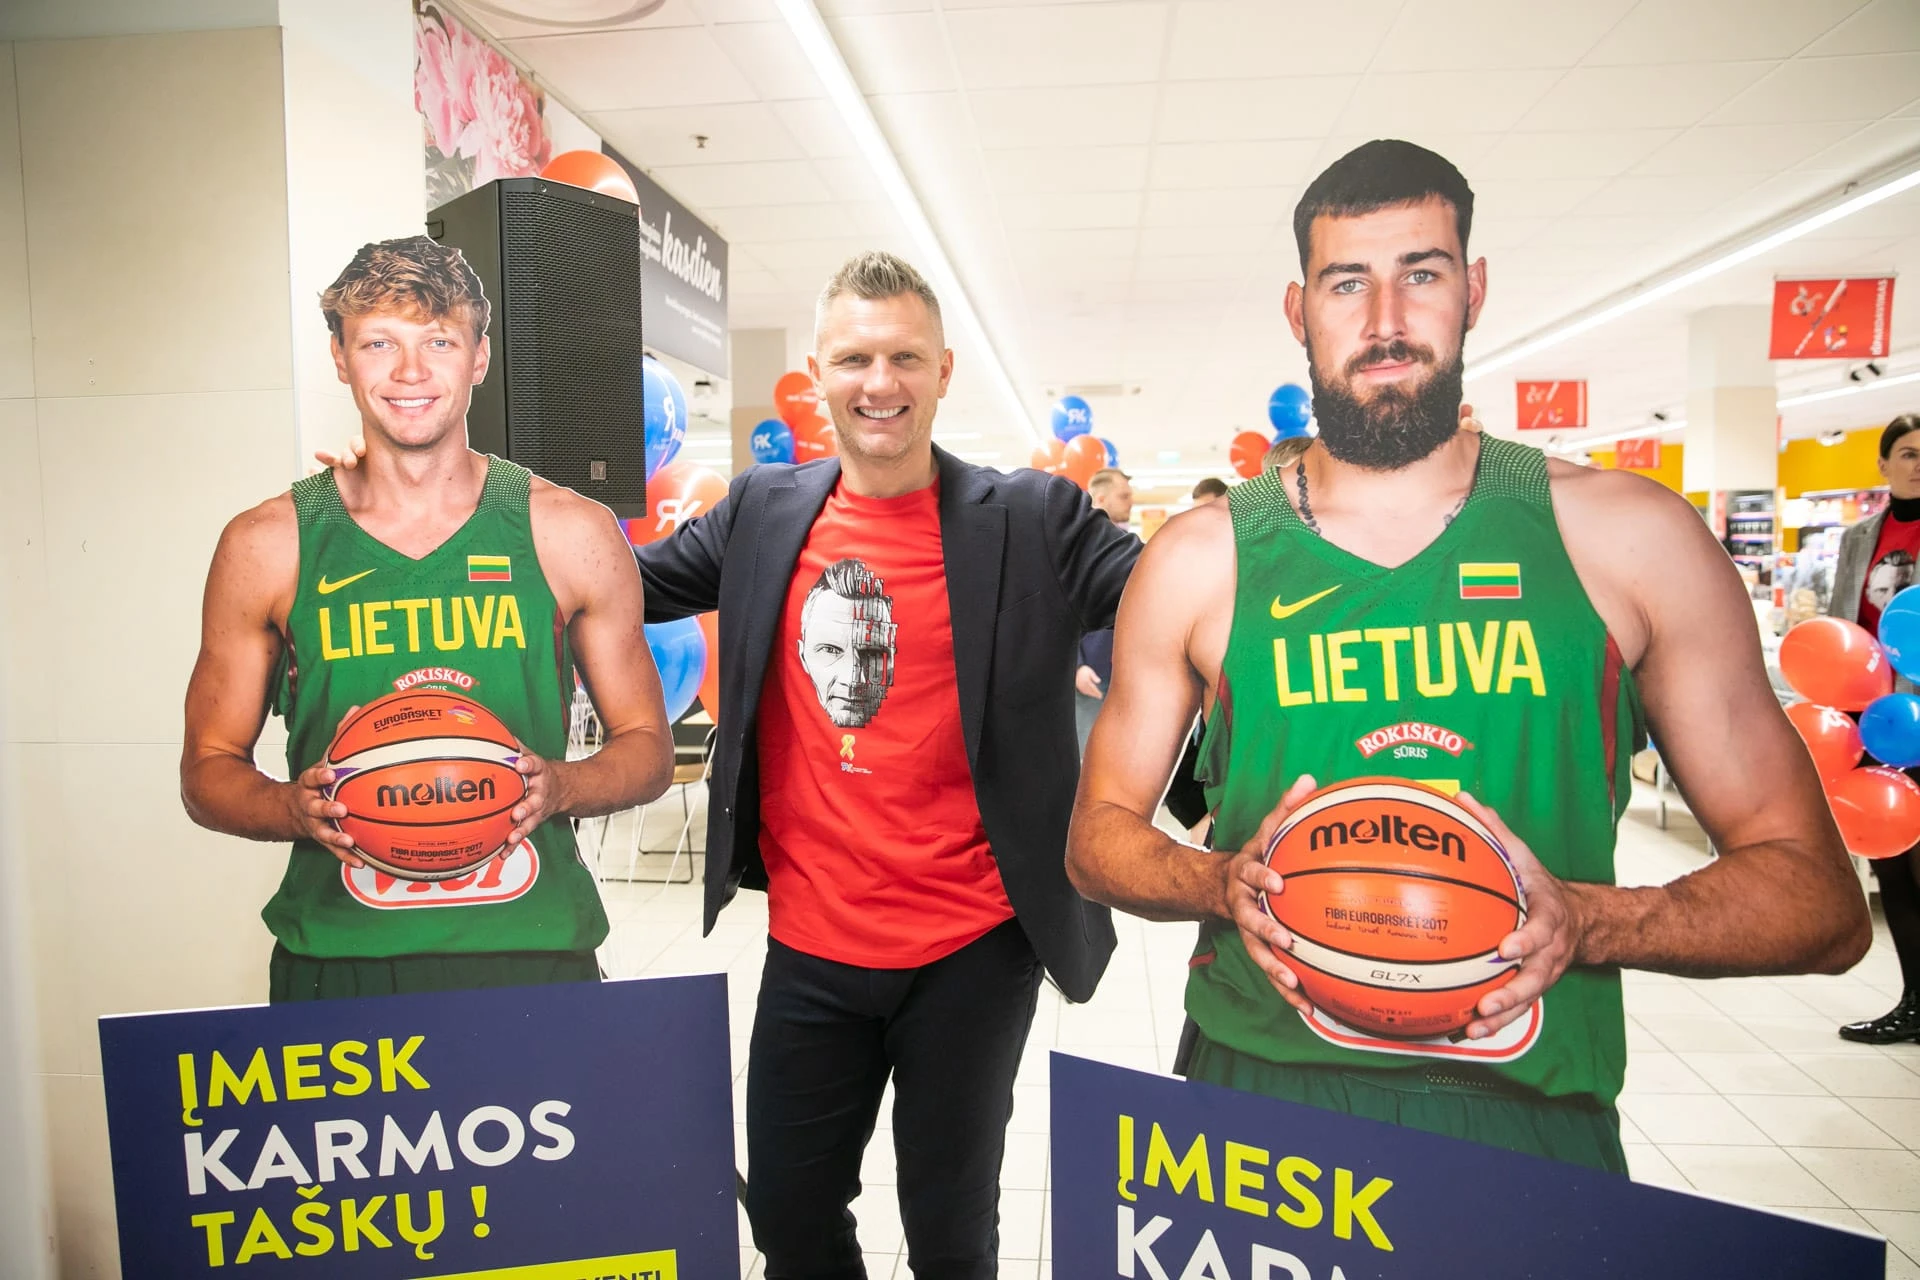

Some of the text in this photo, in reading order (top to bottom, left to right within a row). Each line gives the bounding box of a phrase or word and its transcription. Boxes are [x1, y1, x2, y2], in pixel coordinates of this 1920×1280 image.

[661, 211, 722, 302] kasdien
[319, 595, 526, 660] LIETUVA
[1273, 620, 1547, 707] LIETUVA
[373, 709, 442, 730] EUROBASKET
[377, 776, 495, 807] molten
[465, 842, 483, 853] 2017
[1310, 814, 1466, 862] molten
[1325, 907, 1348, 921] FIBA
[1349, 911, 1420, 929] EUROBASKET
[1422, 919, 1449, 931] 2017
[1370, 969, 1423, 984] GL7X
[178, 1035, 431, 1126] ĮMESK
[184, 1100, 576, 1194] KARMOS
[1117, 1114, 1394, 1252] ĮMESK
[191, 1184, 446, 1267] TAŠKŲ
